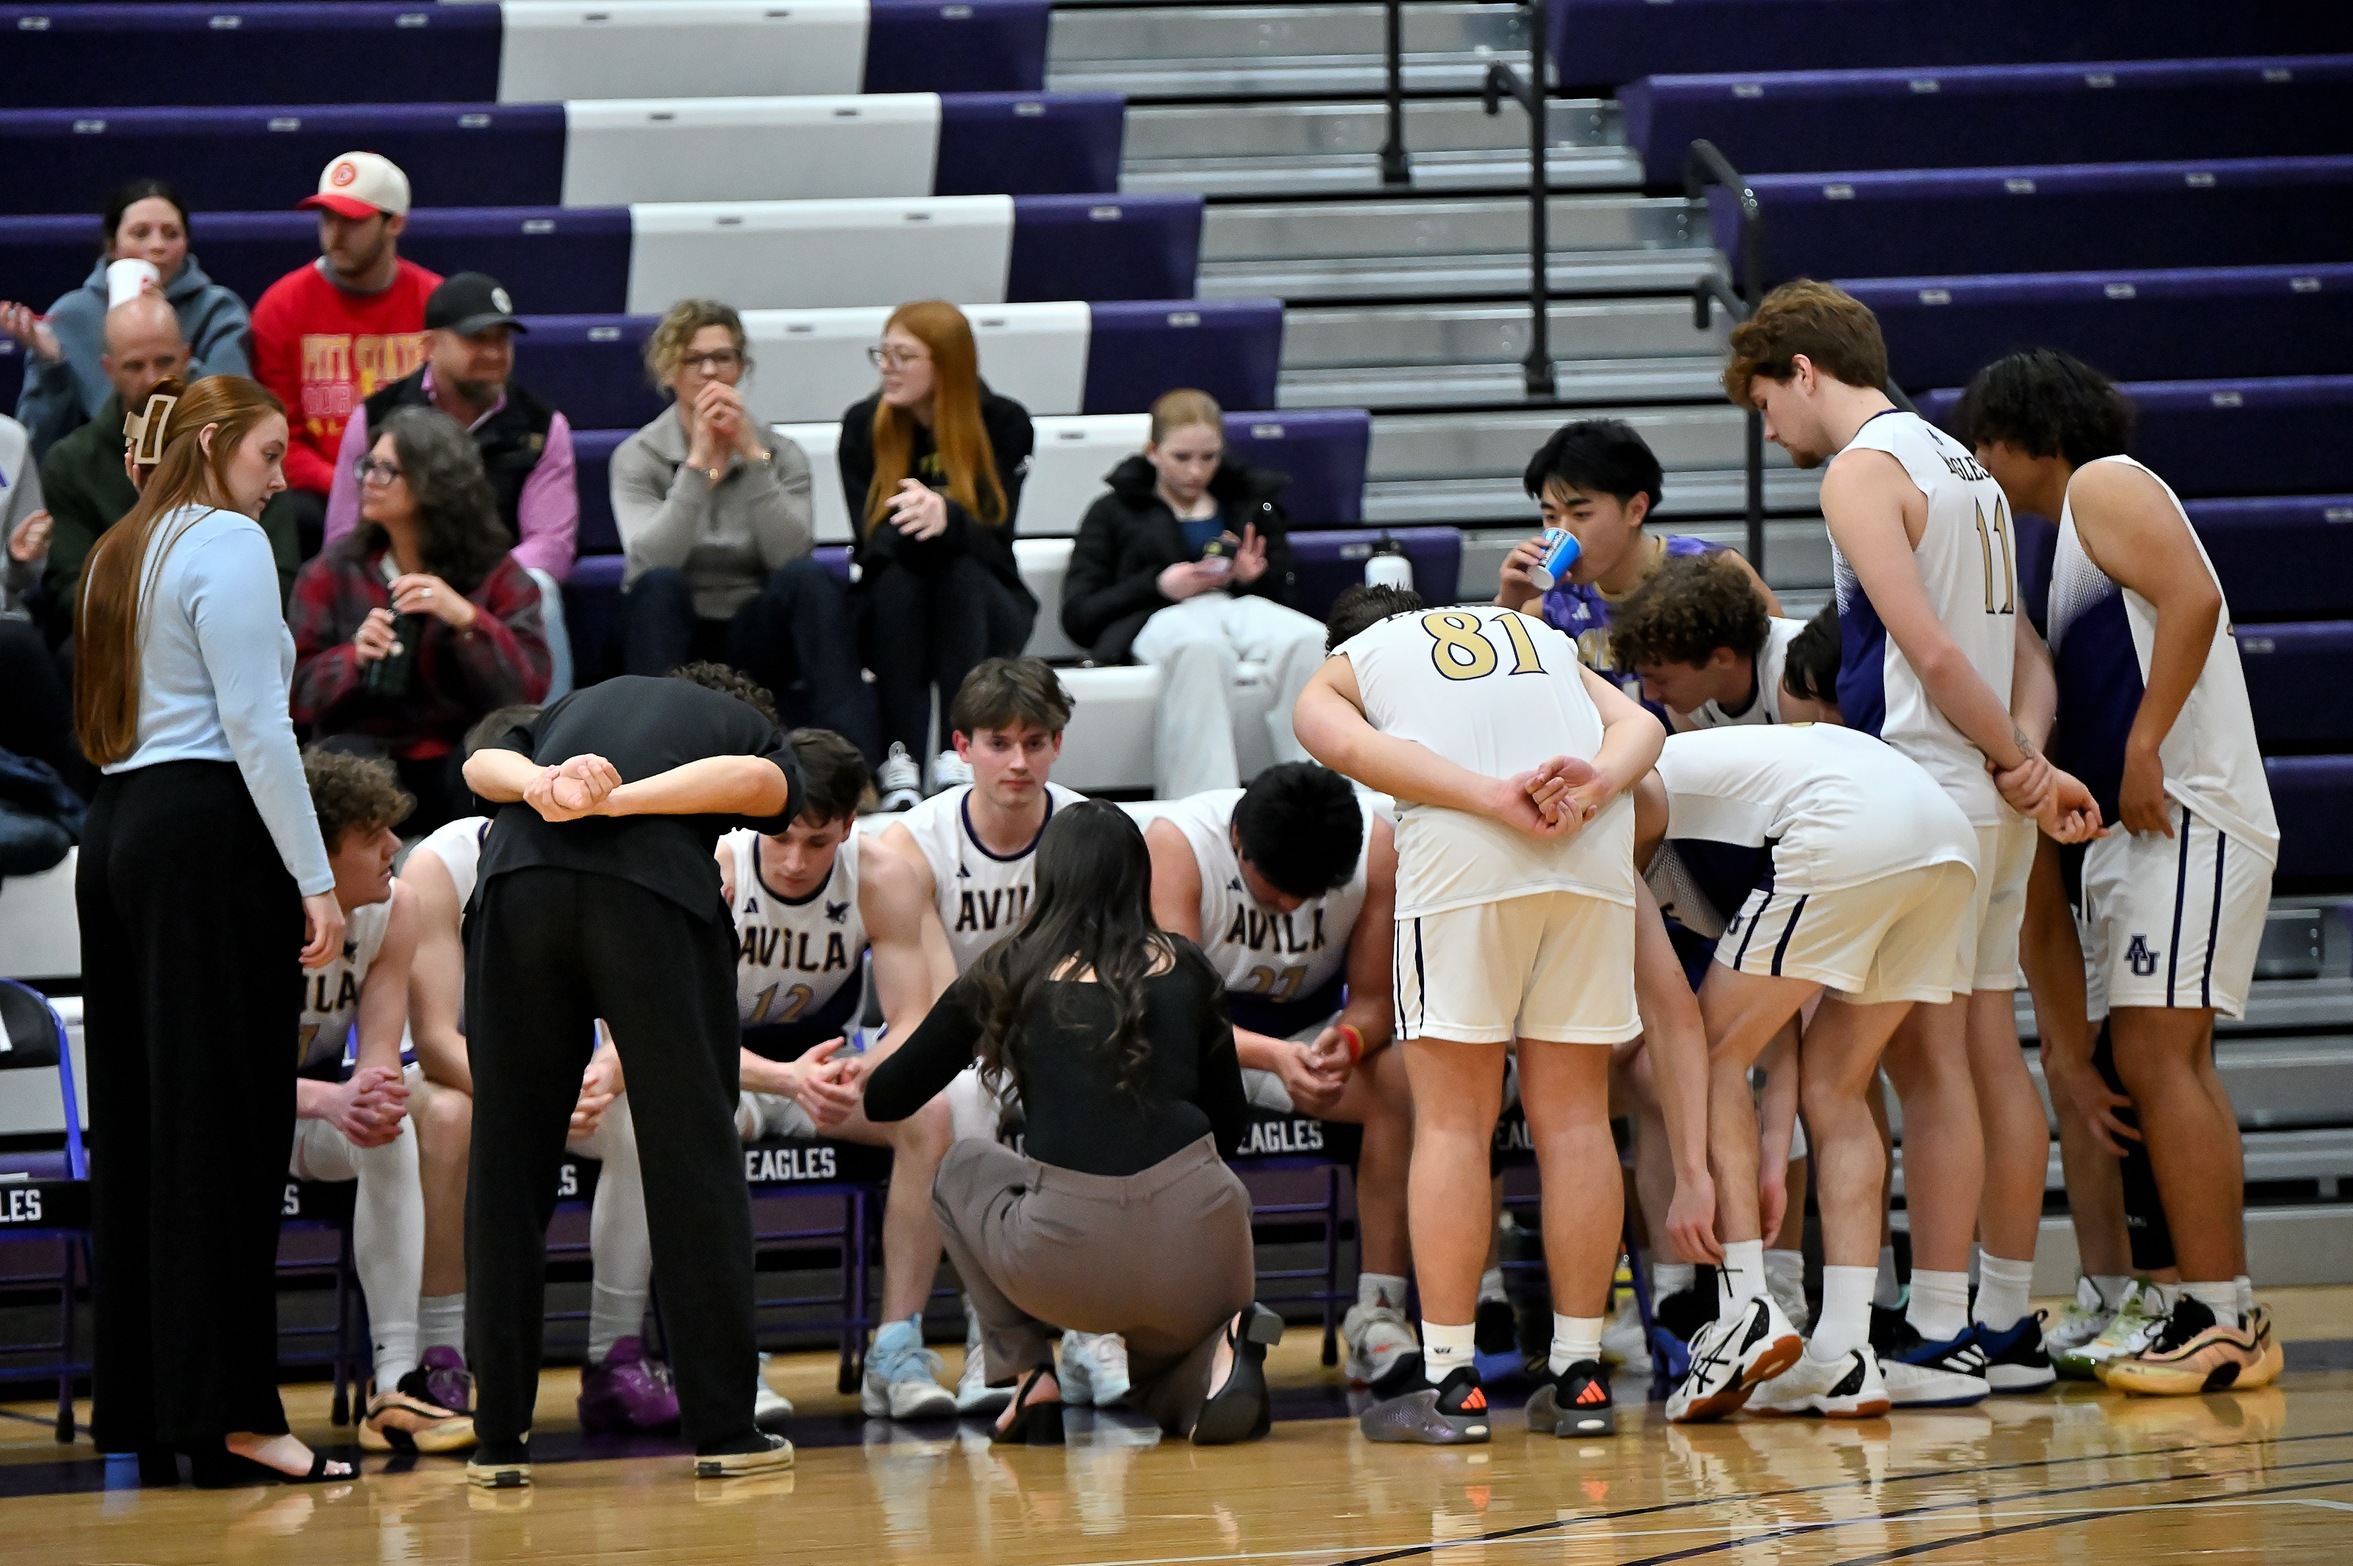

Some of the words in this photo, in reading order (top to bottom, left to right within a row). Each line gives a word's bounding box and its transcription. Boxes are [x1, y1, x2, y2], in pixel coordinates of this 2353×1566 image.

[1975, 494, 2014, 614] 11
[1421, 611, 1548, 681] 81
[740, 926, 847, 973] AVILA
[2124, 933, 2160, 976] AU
[751, 982, 814, 1024] 12
[745, 1147, 837, 1181] EAGLES
